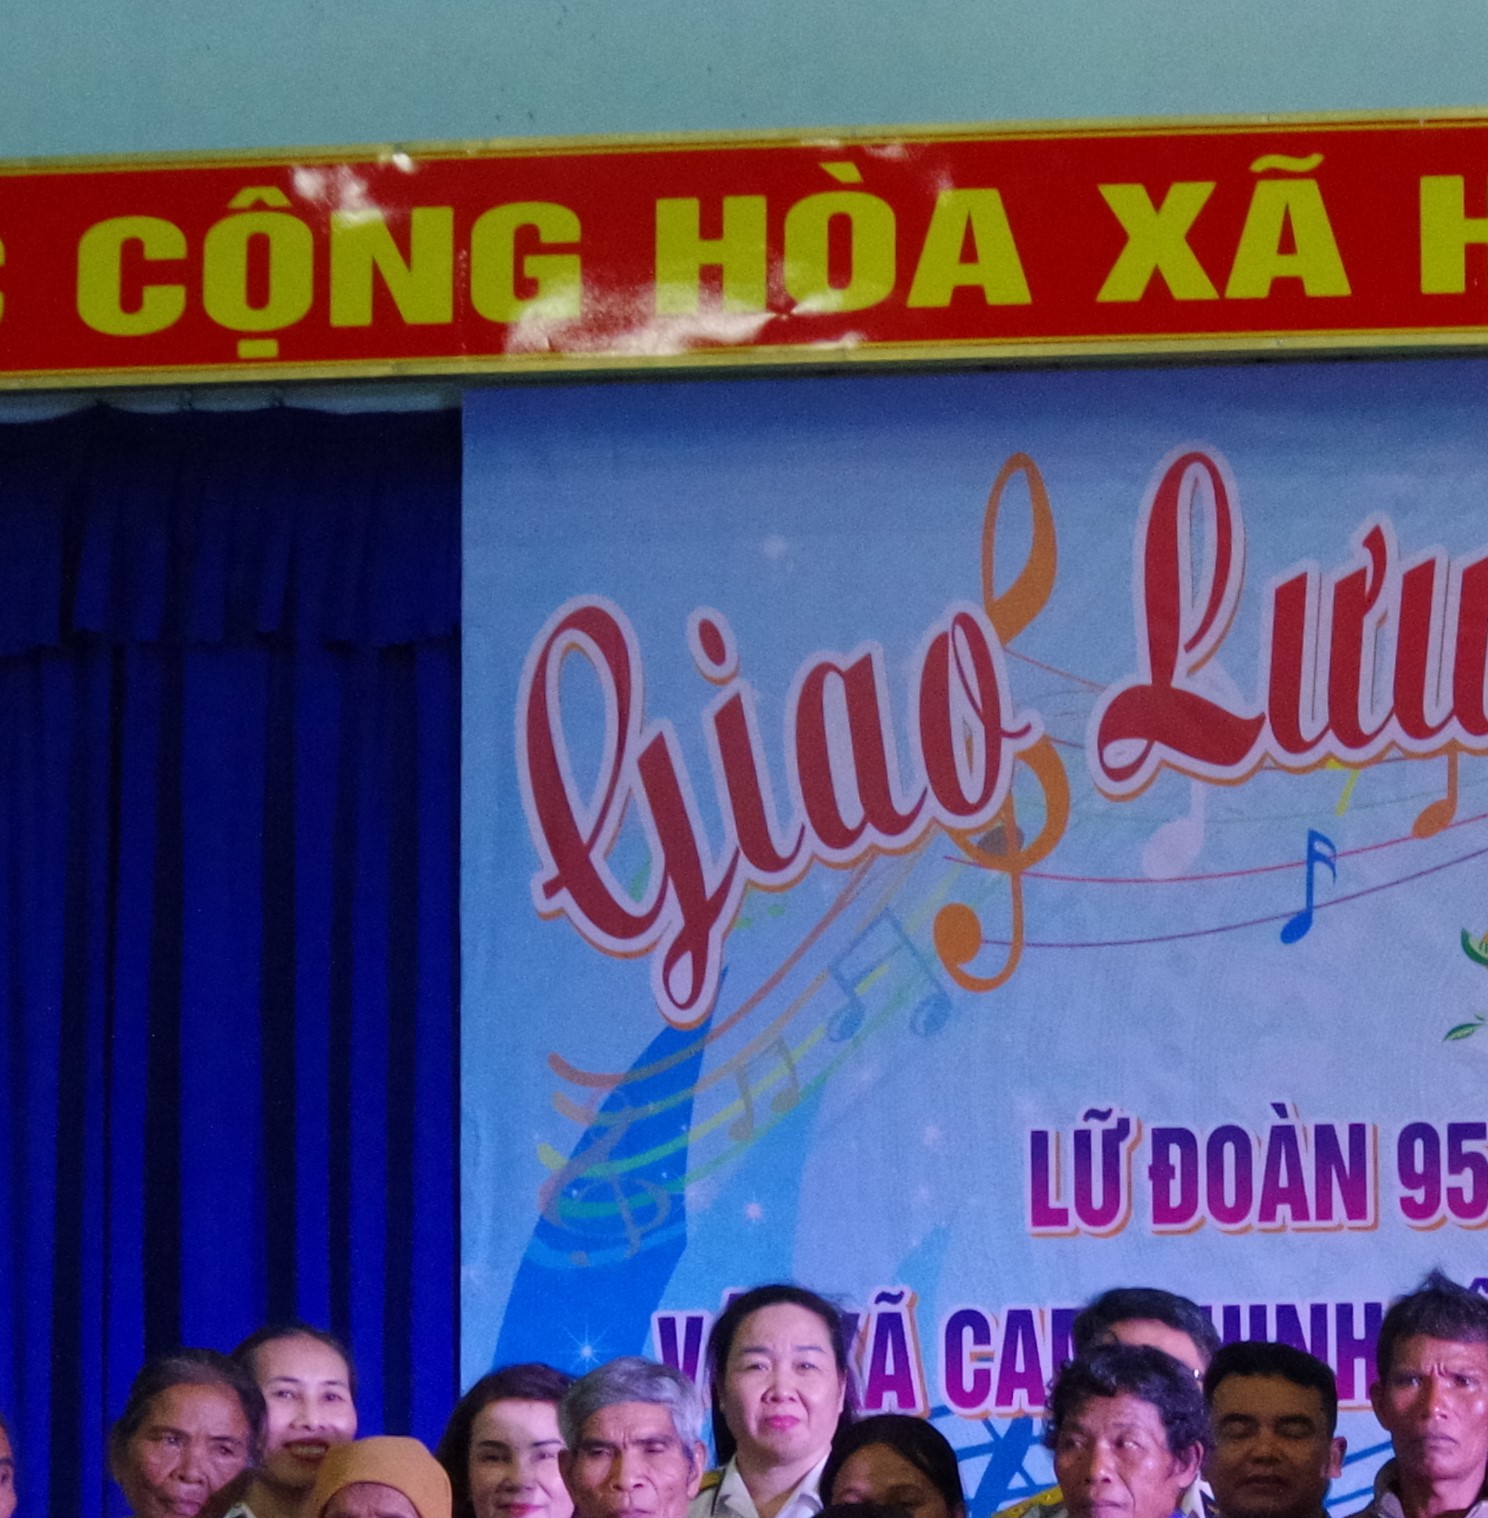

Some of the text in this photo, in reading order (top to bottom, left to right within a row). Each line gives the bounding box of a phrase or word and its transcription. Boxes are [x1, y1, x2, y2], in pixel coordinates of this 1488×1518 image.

[76, 186, 585, 359] CỘNG
[652, 161, 1032, 318] HÒA
[1096, 153, 1352, 302] XÃ
[524, 604, 1034, 1012] Giao
[1029, 1107, 1131, 1229] LỮ
[1147, 1102, 1370, 1226] ĐOÀN
